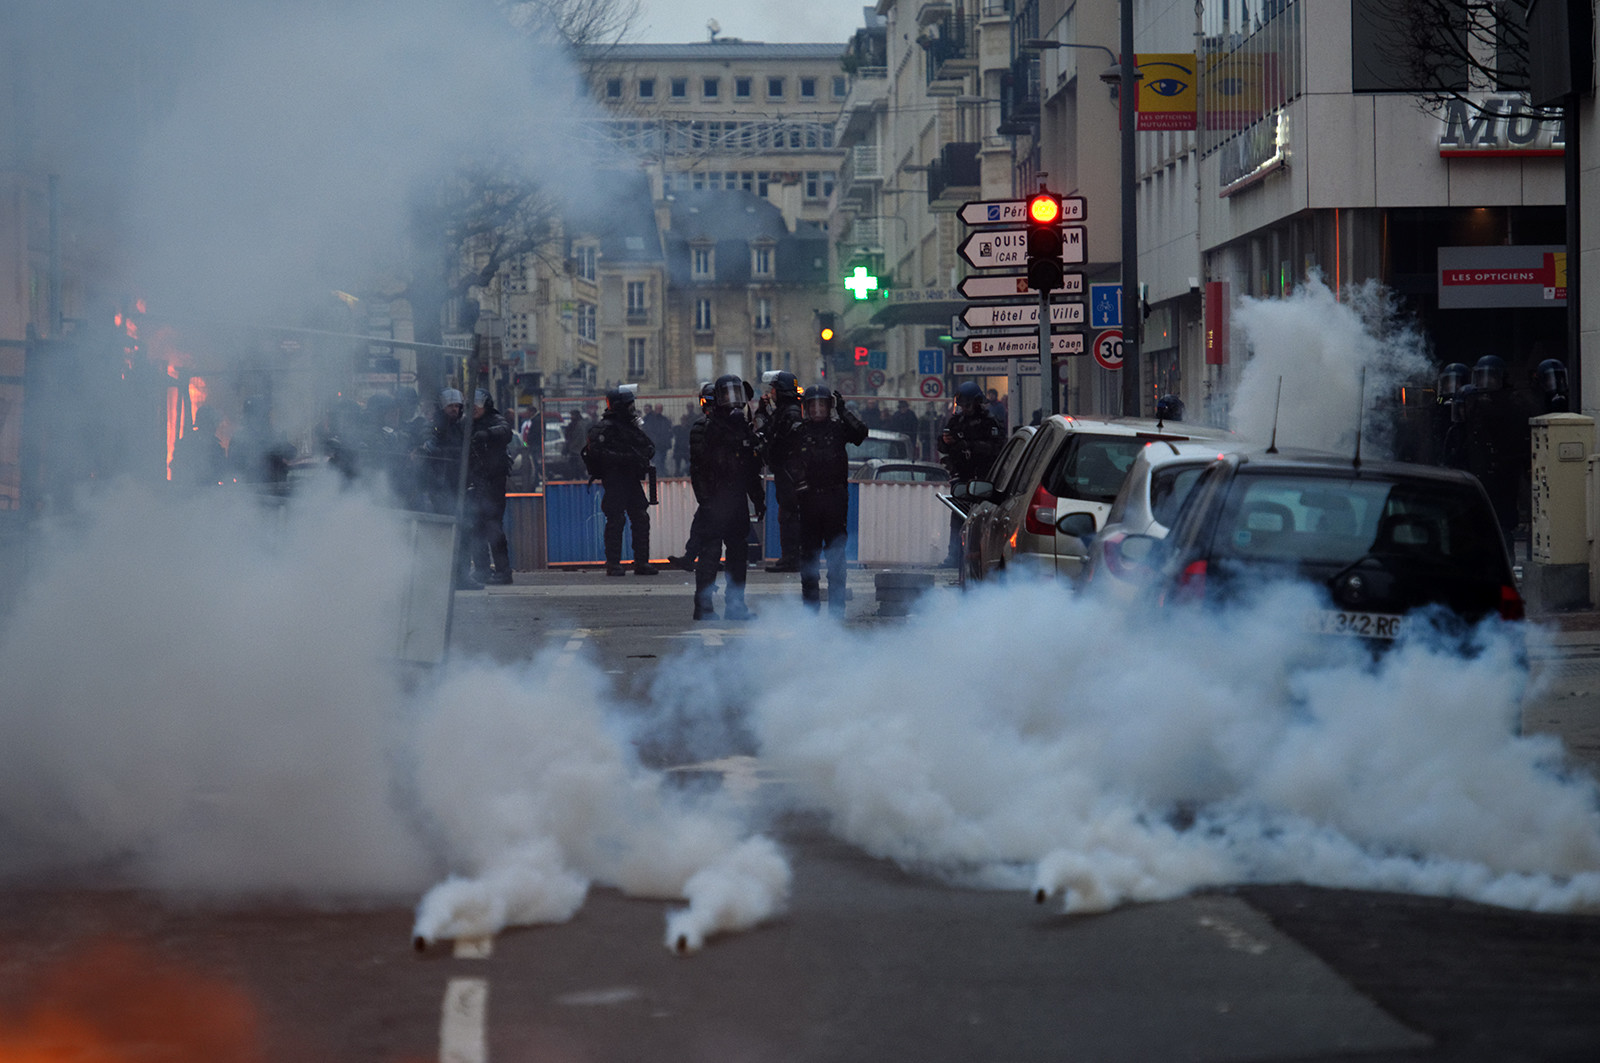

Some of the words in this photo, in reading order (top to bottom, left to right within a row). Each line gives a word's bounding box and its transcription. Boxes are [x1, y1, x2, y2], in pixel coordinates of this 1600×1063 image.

[1452, 273, 1471, 281] LES
[1475, 272, 1535, 280] OPTICIENS
[992, 309, 1023, 322] Hôtel
[1053, 307, 1080, 320] Ville
[984, 342, 993, 352] Le
[998, 340, 1039, 352] Mémoria
[1059, 339, 1081, 349] Caen
[1101, 341, 1123, 359] 30
[854, 346, 868, 360] P
[1019, 364, 1037, 372] Caen
[924, 383, 939, 394] 30
